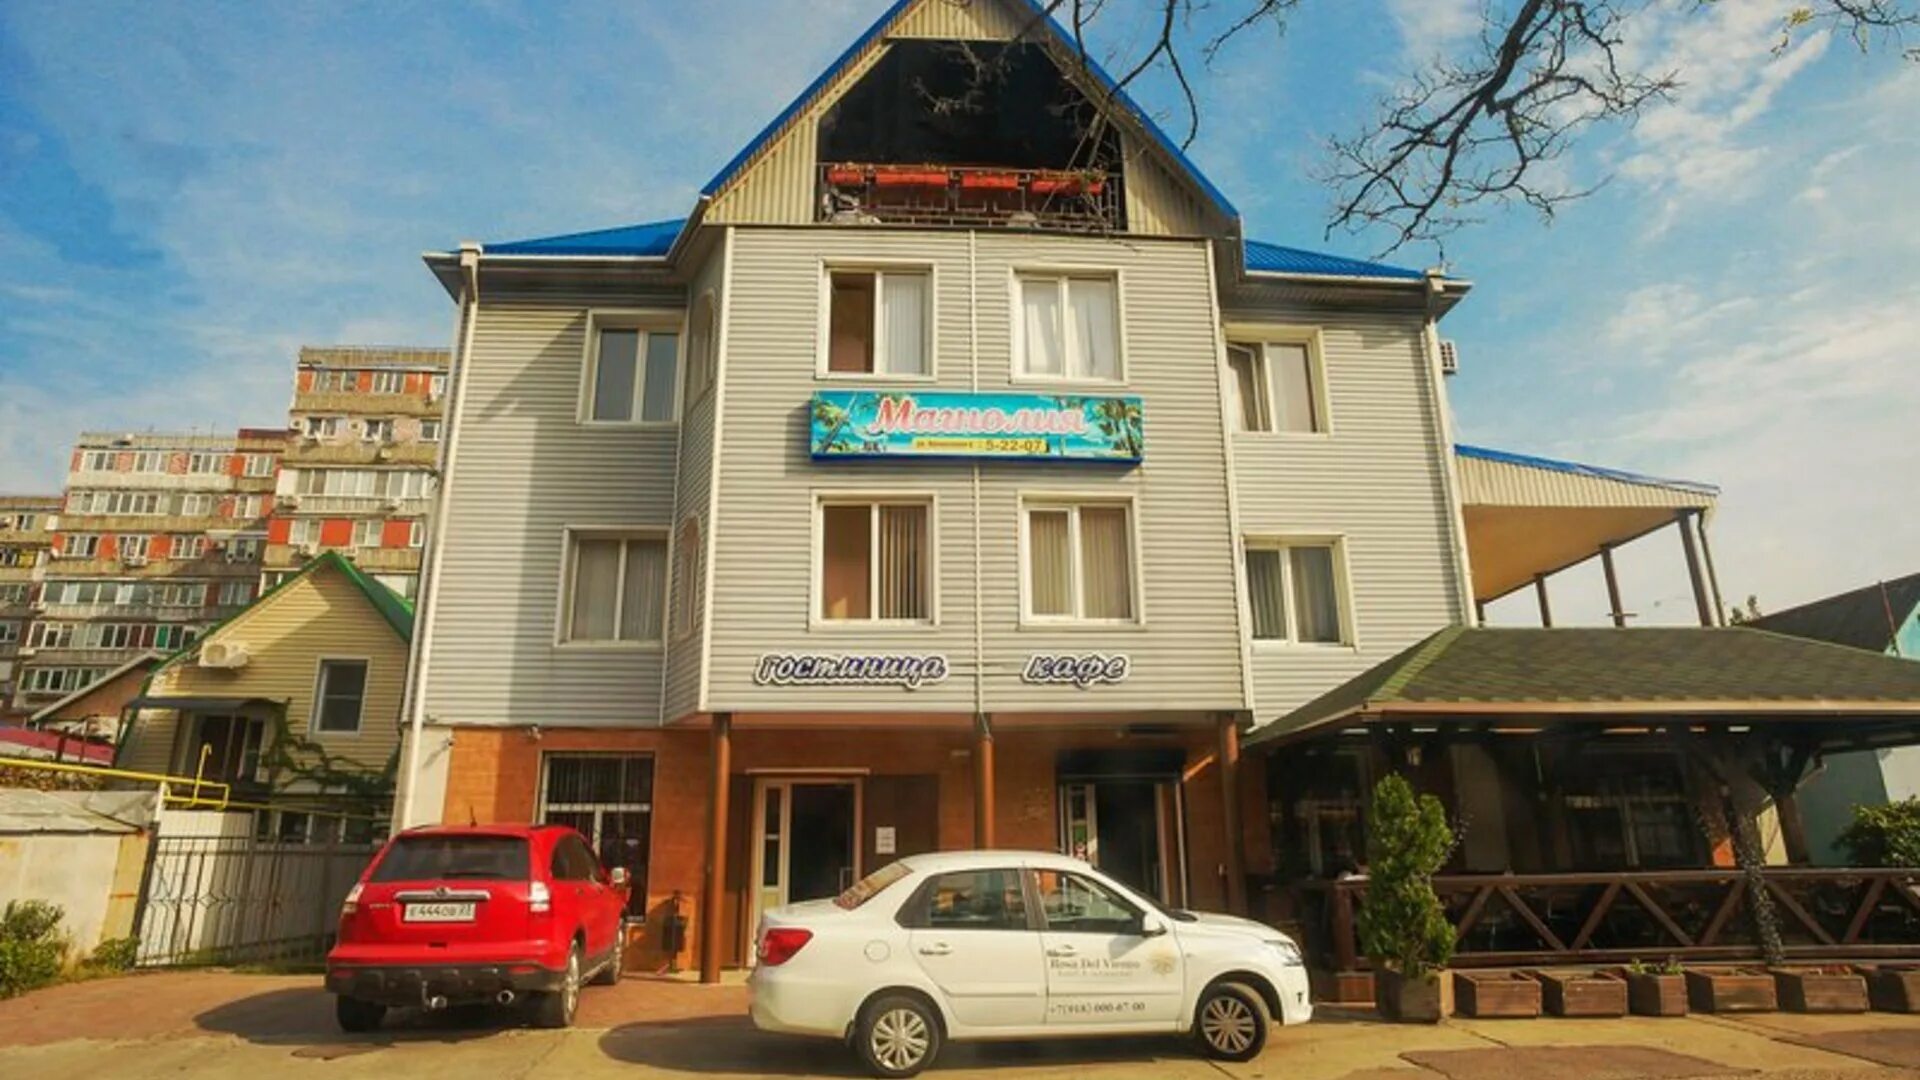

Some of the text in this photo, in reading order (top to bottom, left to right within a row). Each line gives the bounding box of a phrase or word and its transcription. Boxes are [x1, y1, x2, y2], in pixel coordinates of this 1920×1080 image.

[870, 396, 1087, 433] Магнолия
[985, 439, 1042, 453] 5-22-07
[1026, 654, 1127, 684] кафе
[1050, 958, 1078, 970] Rosa
[1081, 958, 1100, 970] Del
